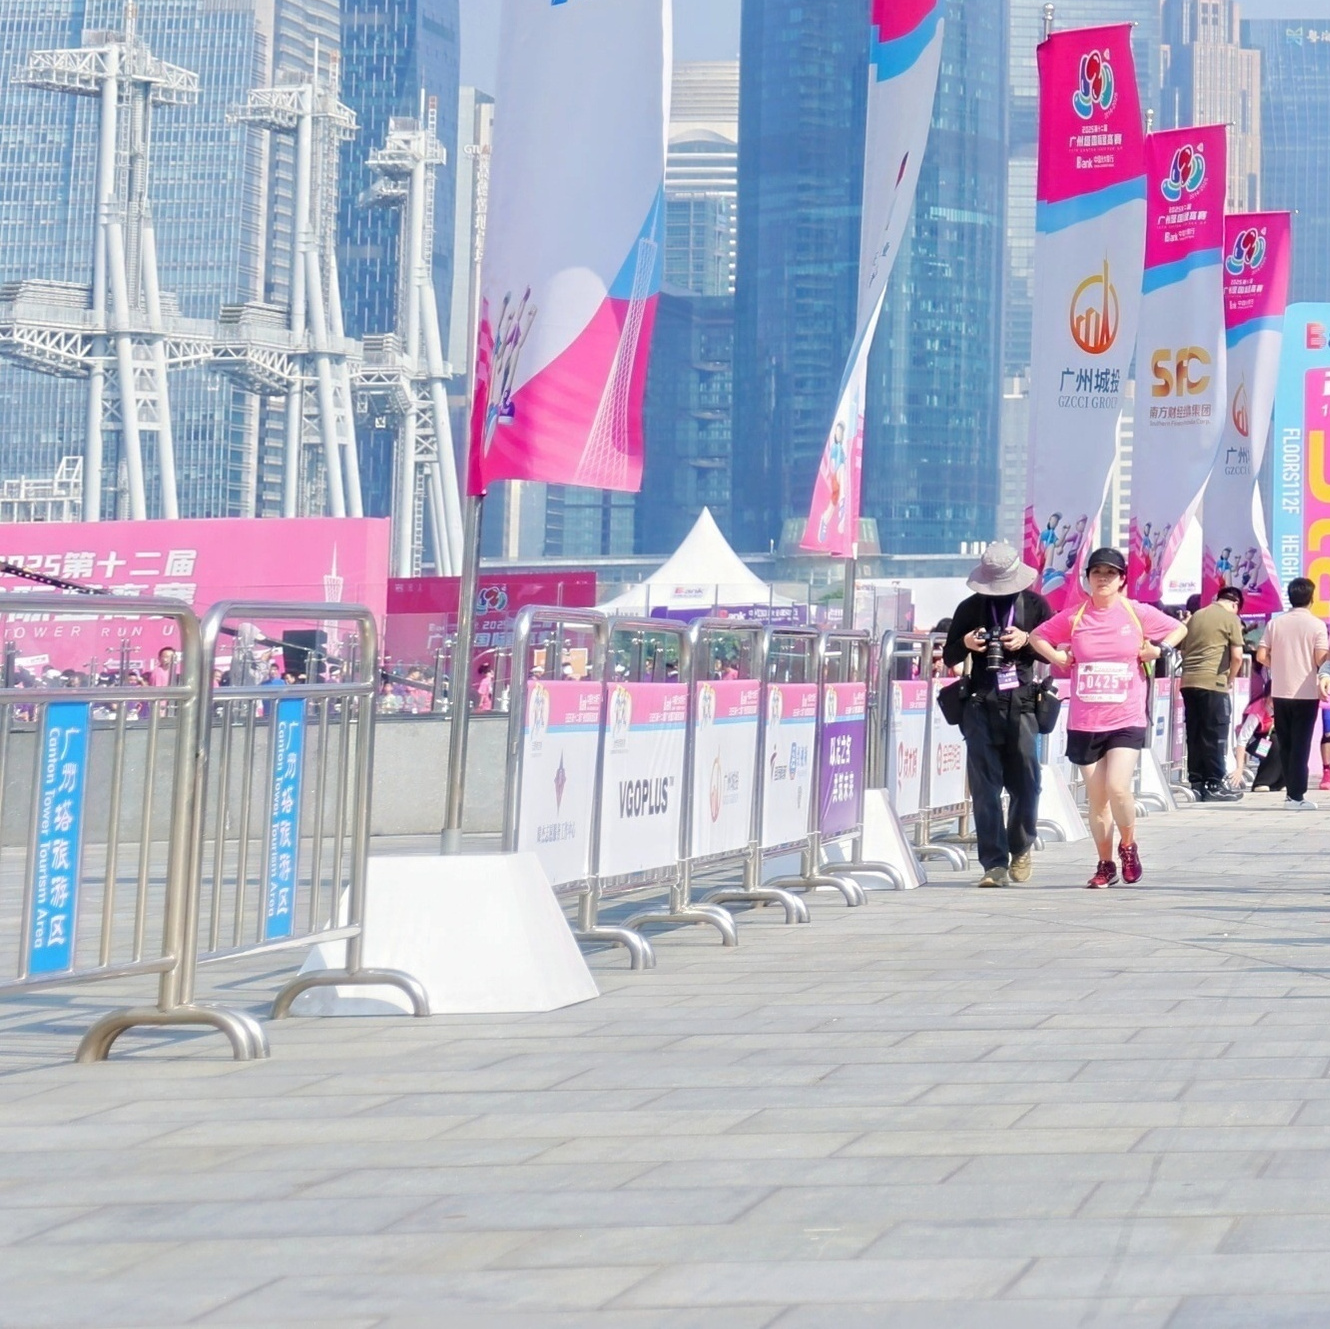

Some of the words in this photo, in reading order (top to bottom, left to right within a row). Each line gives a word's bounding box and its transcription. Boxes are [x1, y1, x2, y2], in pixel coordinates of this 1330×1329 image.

[1059, 368, 1121, 394] 广州城投
[1151, 347, 1212, 398] SFC
[1058, 395, 1089, 409] GZCCI
[101, 626, 143, 638] RUN
[1086, 675, 1119, 689] 0425
[45, 726, 61, 785] Canton
[276, 721, 288, 772] Canton
[40, 788, 55, 837] Tower
[272, 776, 285, 818] Tower
[276, 720, 300, 916] 广州塔旅游区
[619, 776, 669, 819] VGOPLUS
[46, 726, 80, 948] 广州塔旅游区
[36, 840, 51, 905] Tourism
[267, 882, 280, 919] Area
[33, 908, 48, 950] Area
